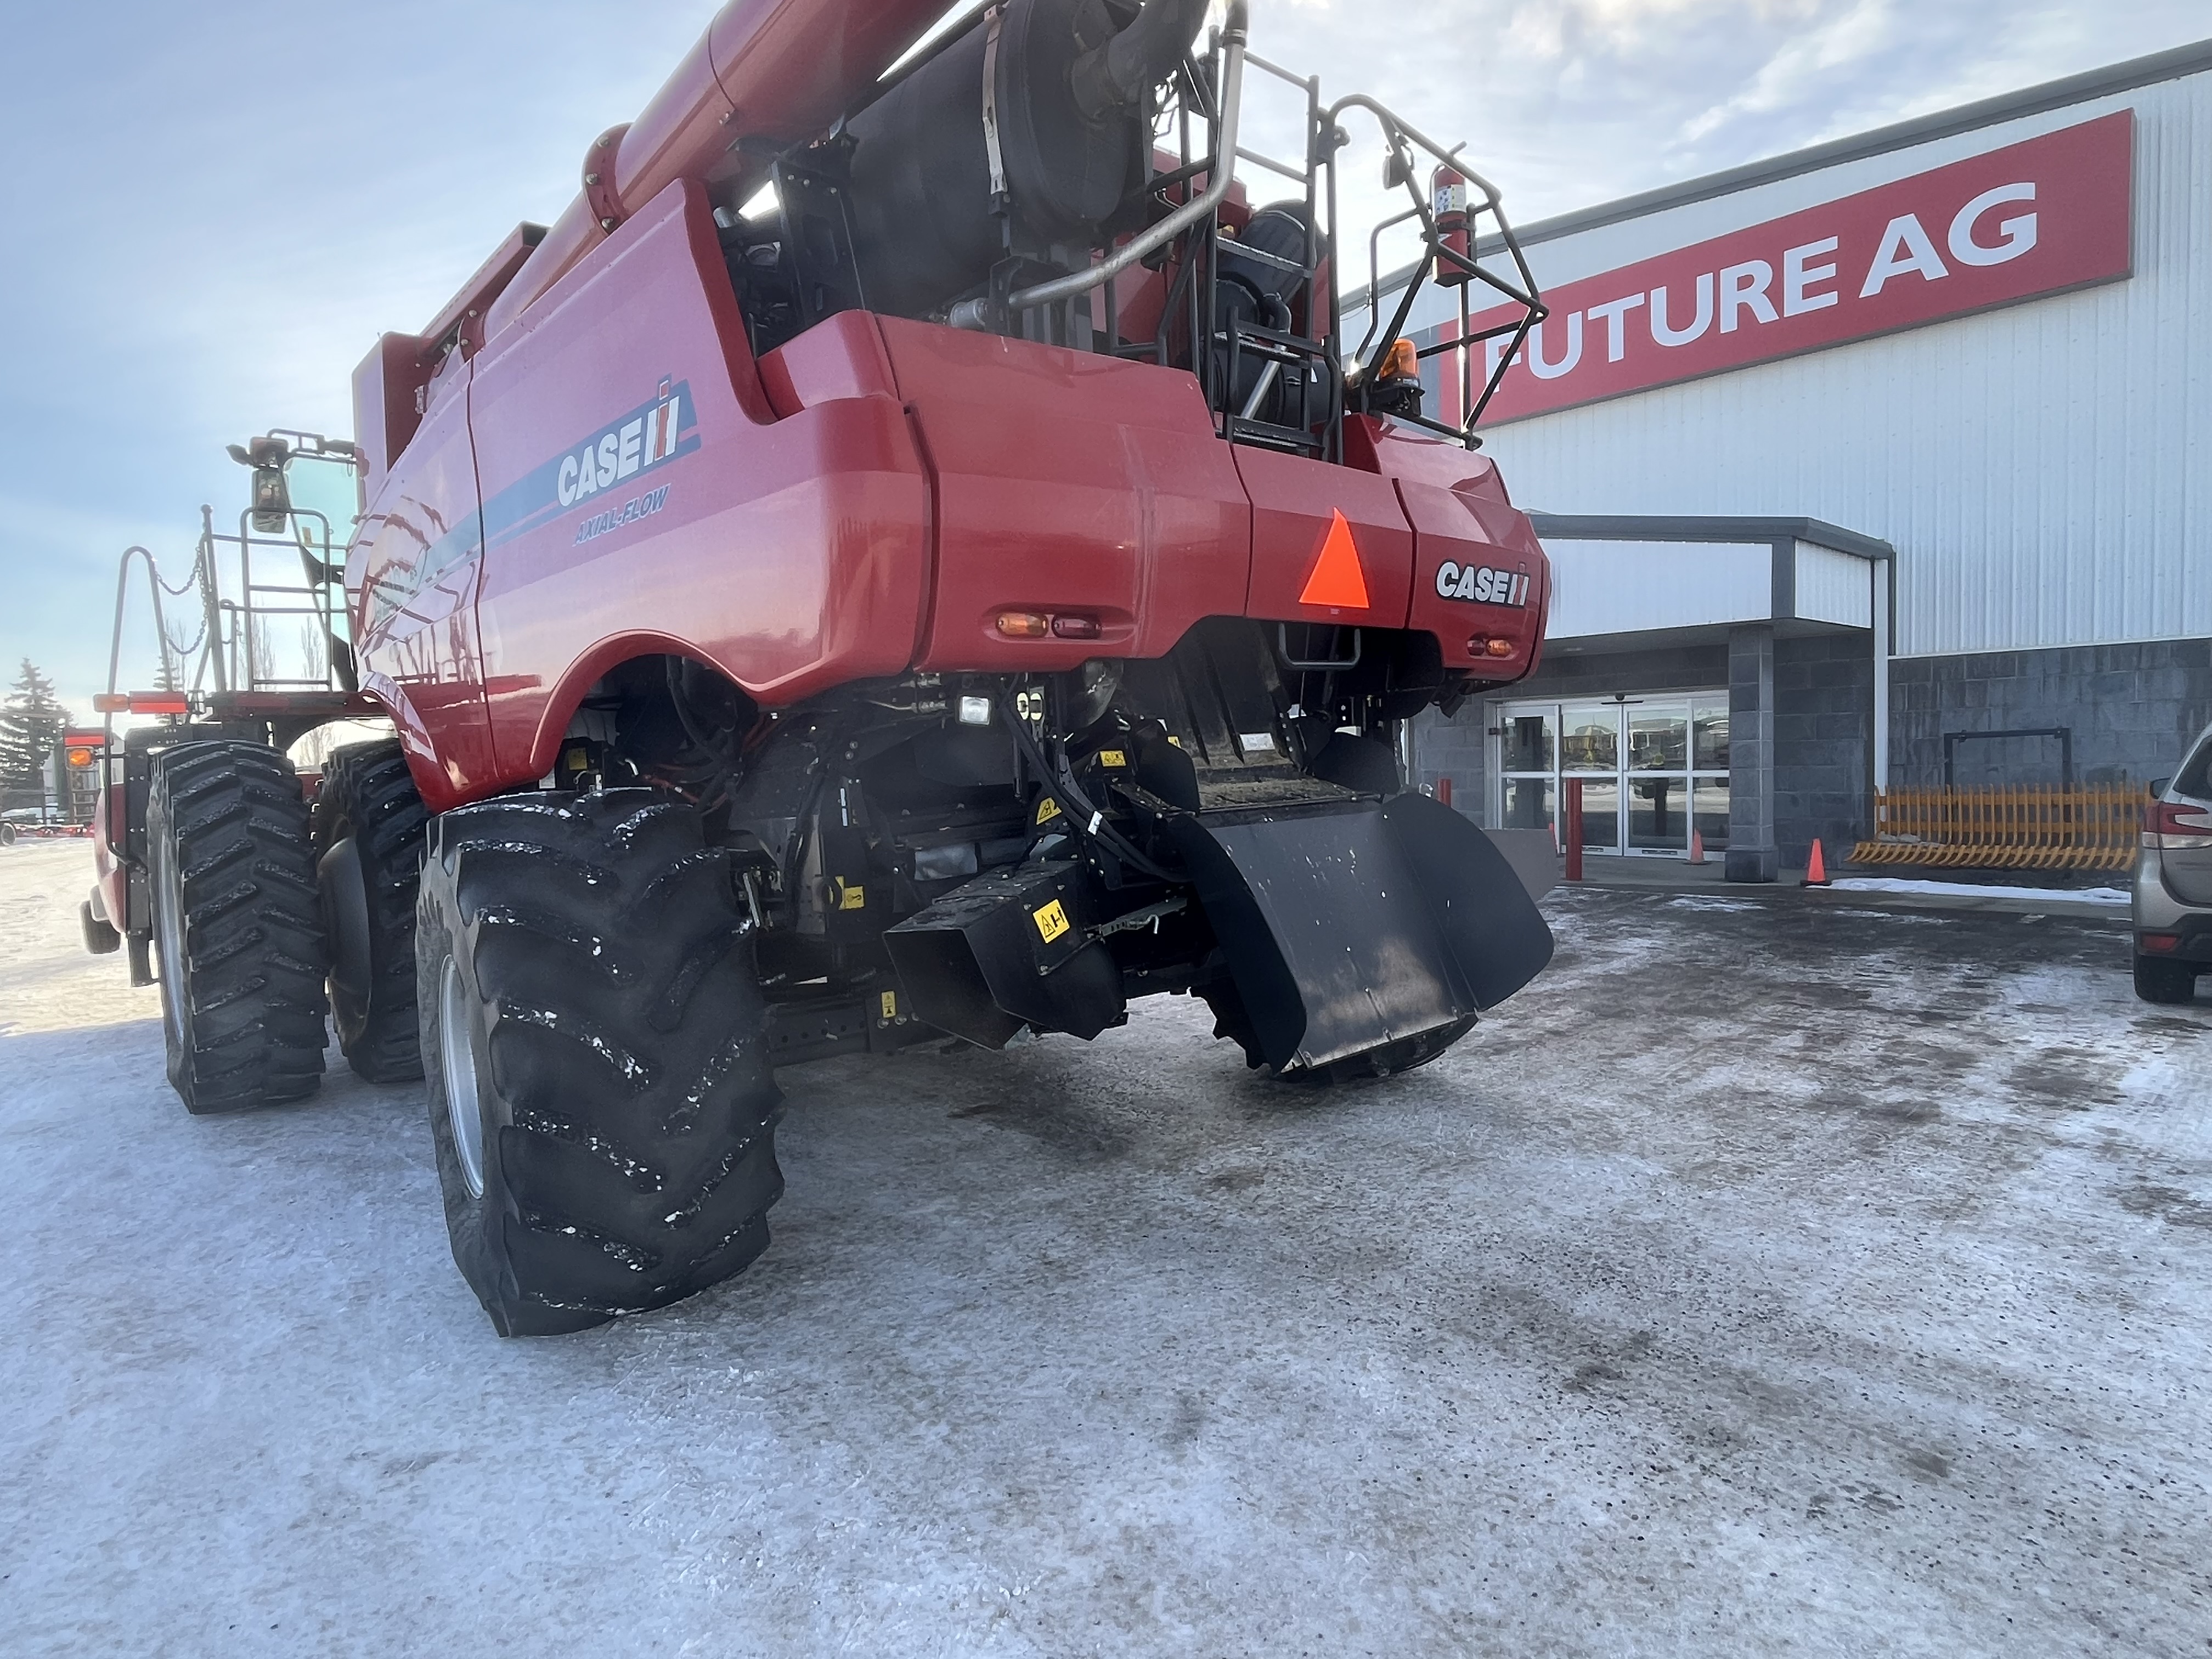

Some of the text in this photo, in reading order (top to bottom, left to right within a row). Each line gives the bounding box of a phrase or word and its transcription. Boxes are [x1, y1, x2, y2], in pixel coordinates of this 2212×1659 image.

[1485, 182, 2038, 393] FUTURE AG
[573, 483, 671, 547] AXIAL-FLOW
